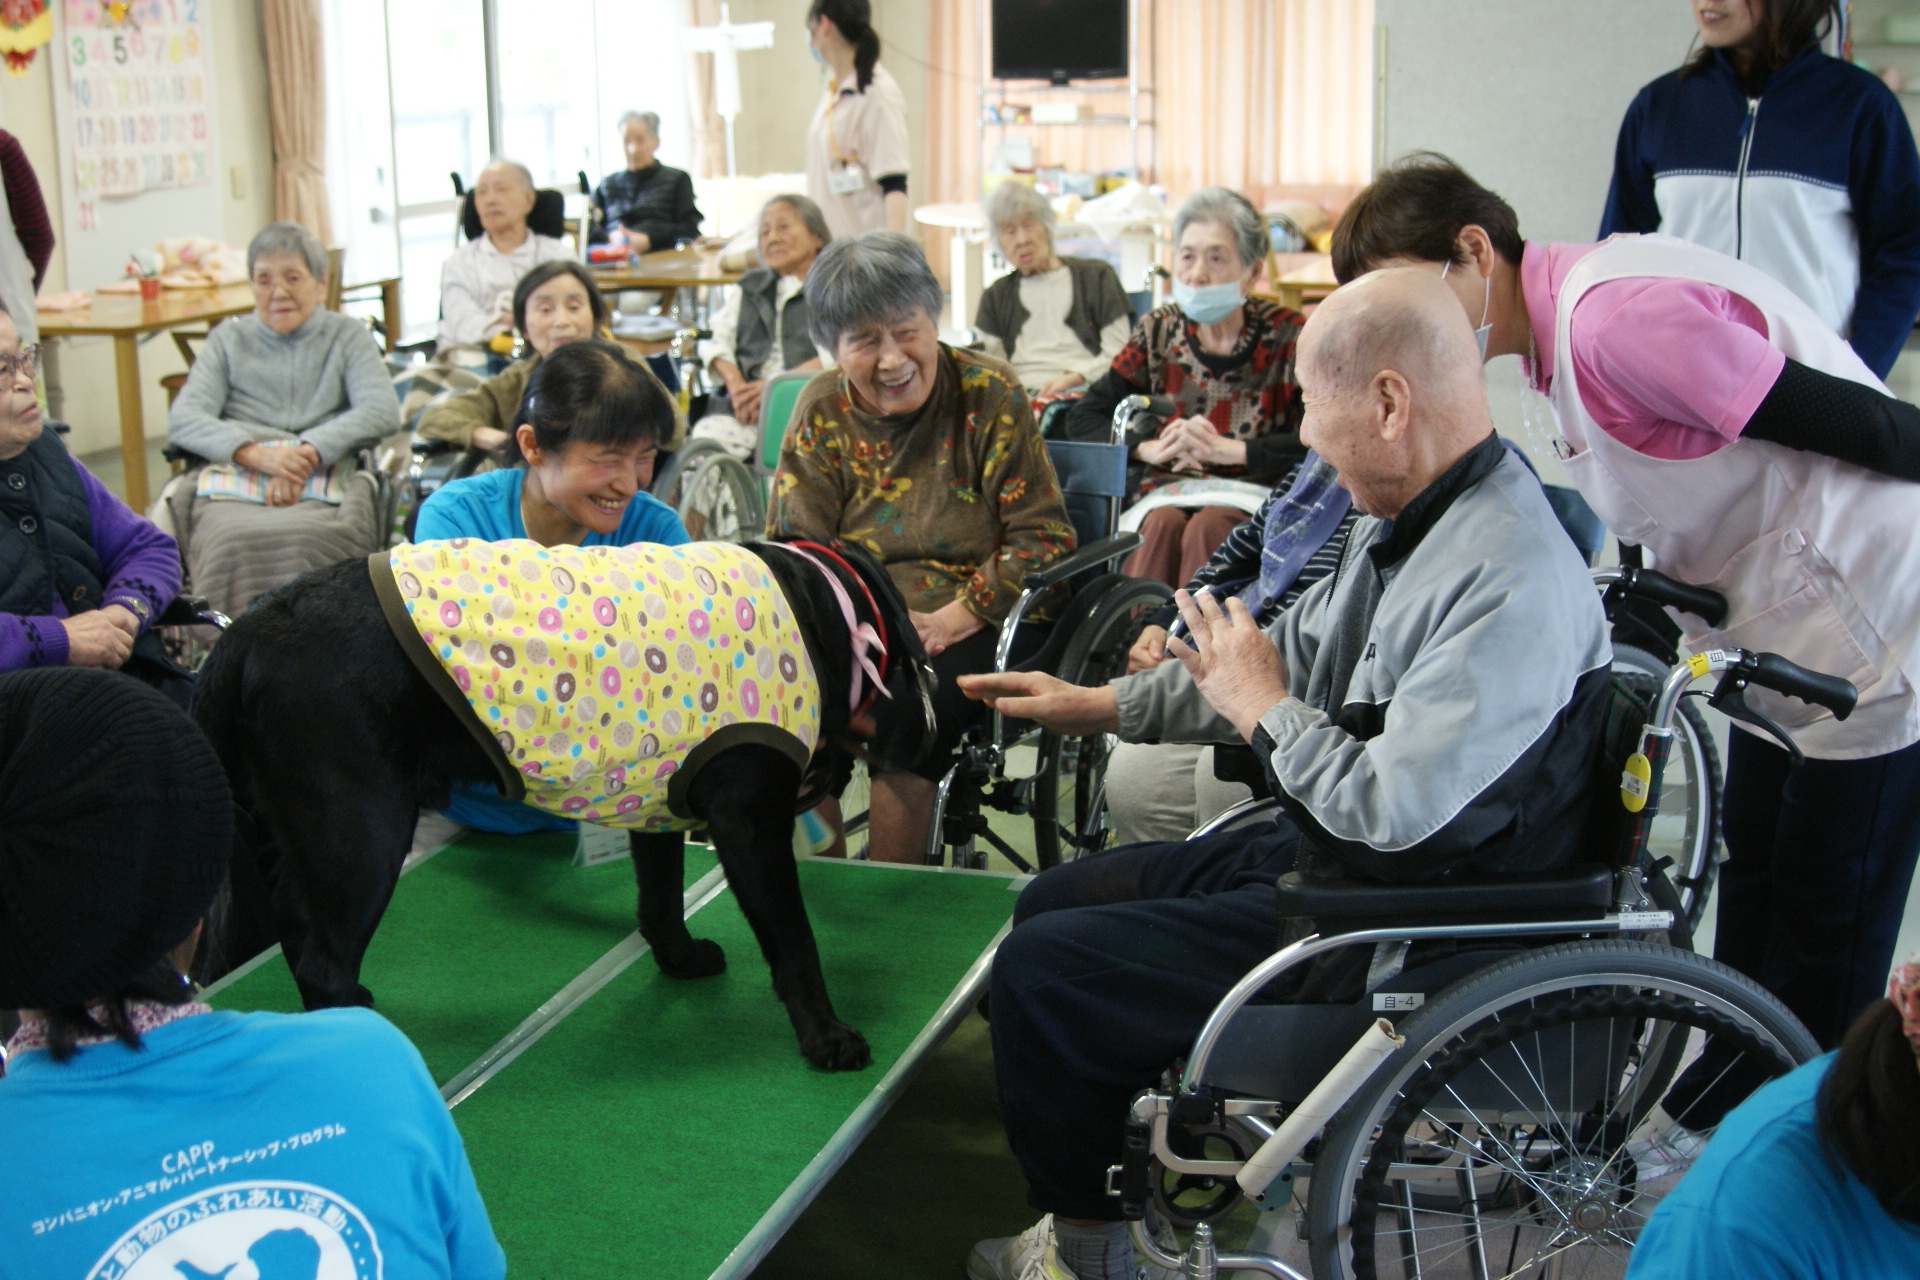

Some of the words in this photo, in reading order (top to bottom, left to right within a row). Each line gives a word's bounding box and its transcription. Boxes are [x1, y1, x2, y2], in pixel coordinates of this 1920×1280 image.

[71, 36, 86, 66] 3
[113, 35, 127, 64] 5
[151, 35, 165, 64] 7
[169, 35, 183, 63] 8
[185, 28, 198, 56] 9
[73, 77, 90, 107] 10
[77, 117, 93, 146] 17
[161, 1140, 215, 1174] CAPP
